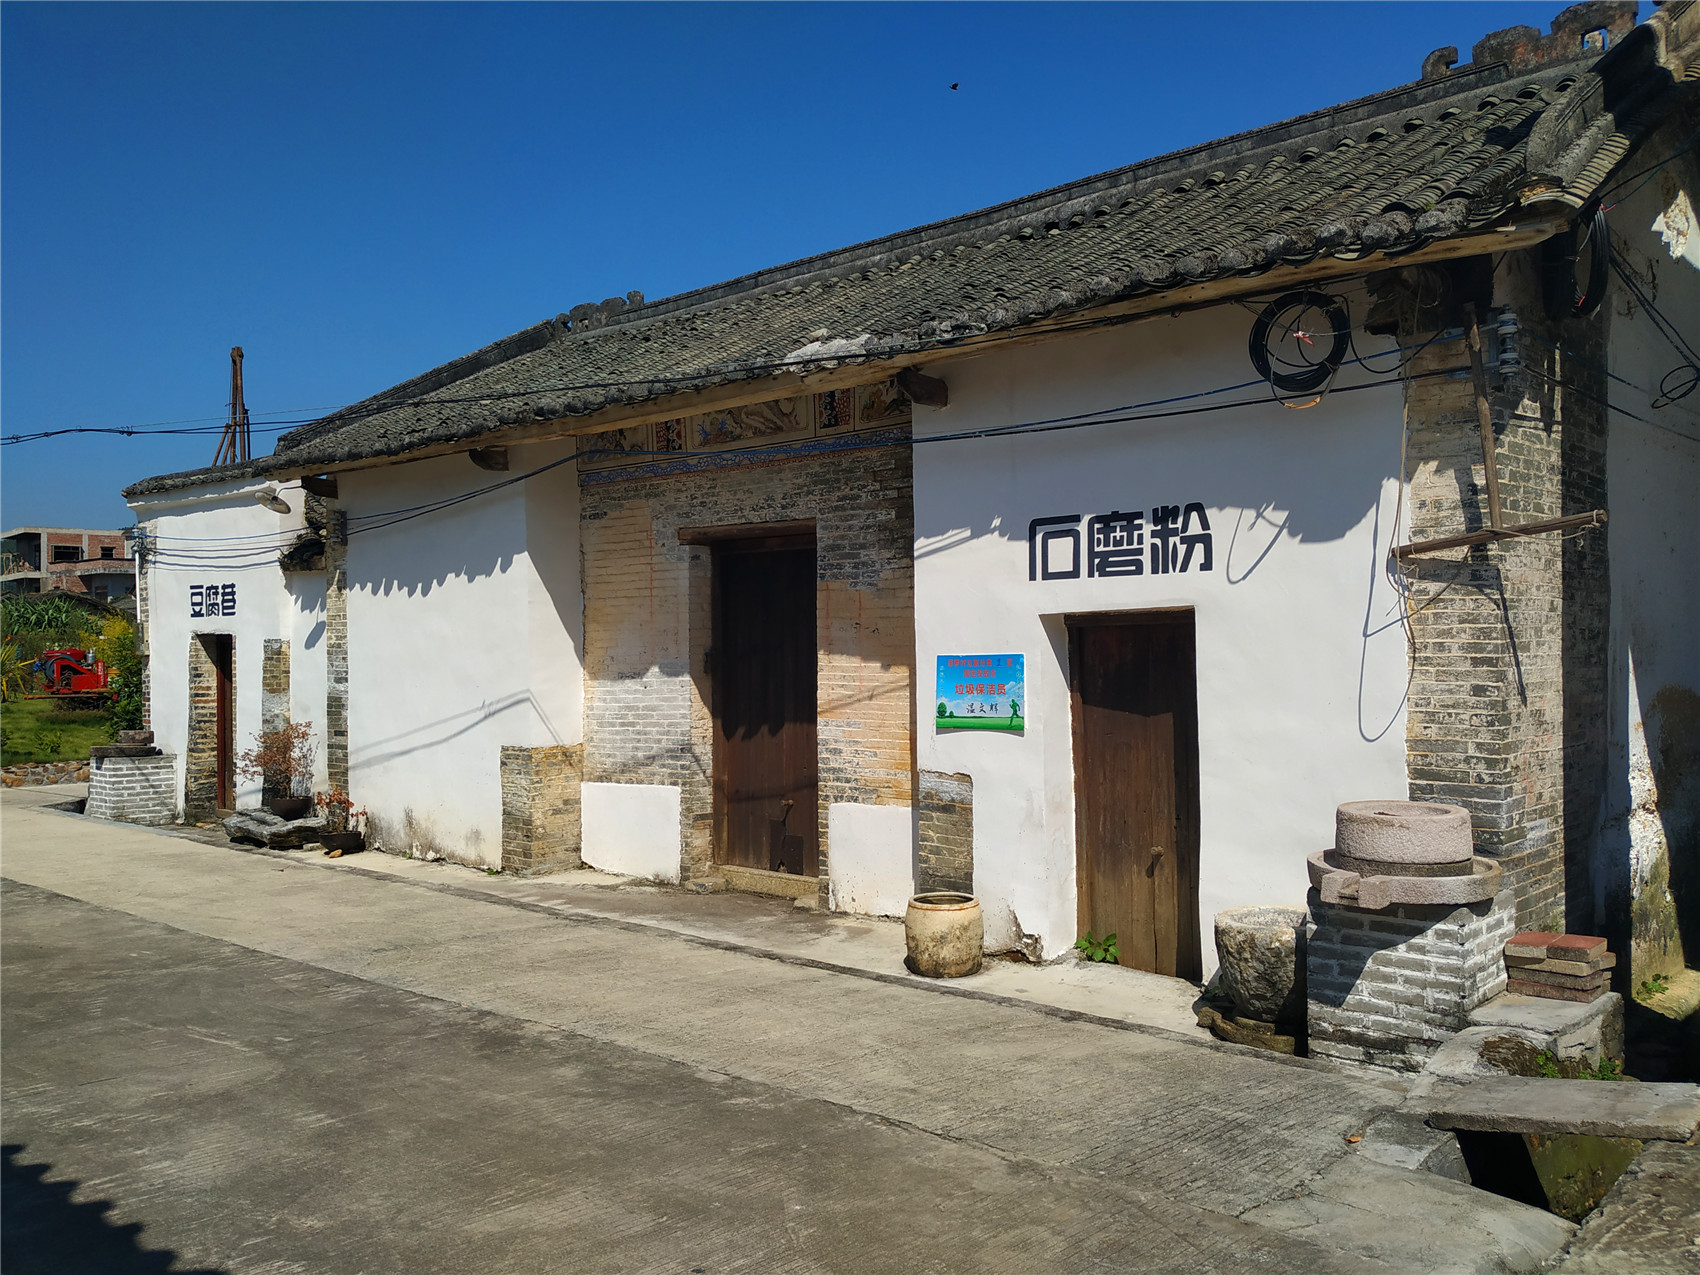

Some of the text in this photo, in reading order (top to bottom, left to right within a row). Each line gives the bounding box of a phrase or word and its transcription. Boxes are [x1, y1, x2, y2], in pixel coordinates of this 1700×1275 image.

[1028, 502, 1213, 582] 石磨粉
[189, 582, 237, 618] 豆腐巷
[955, 683, 1006, 695] 垃圾保洁员
